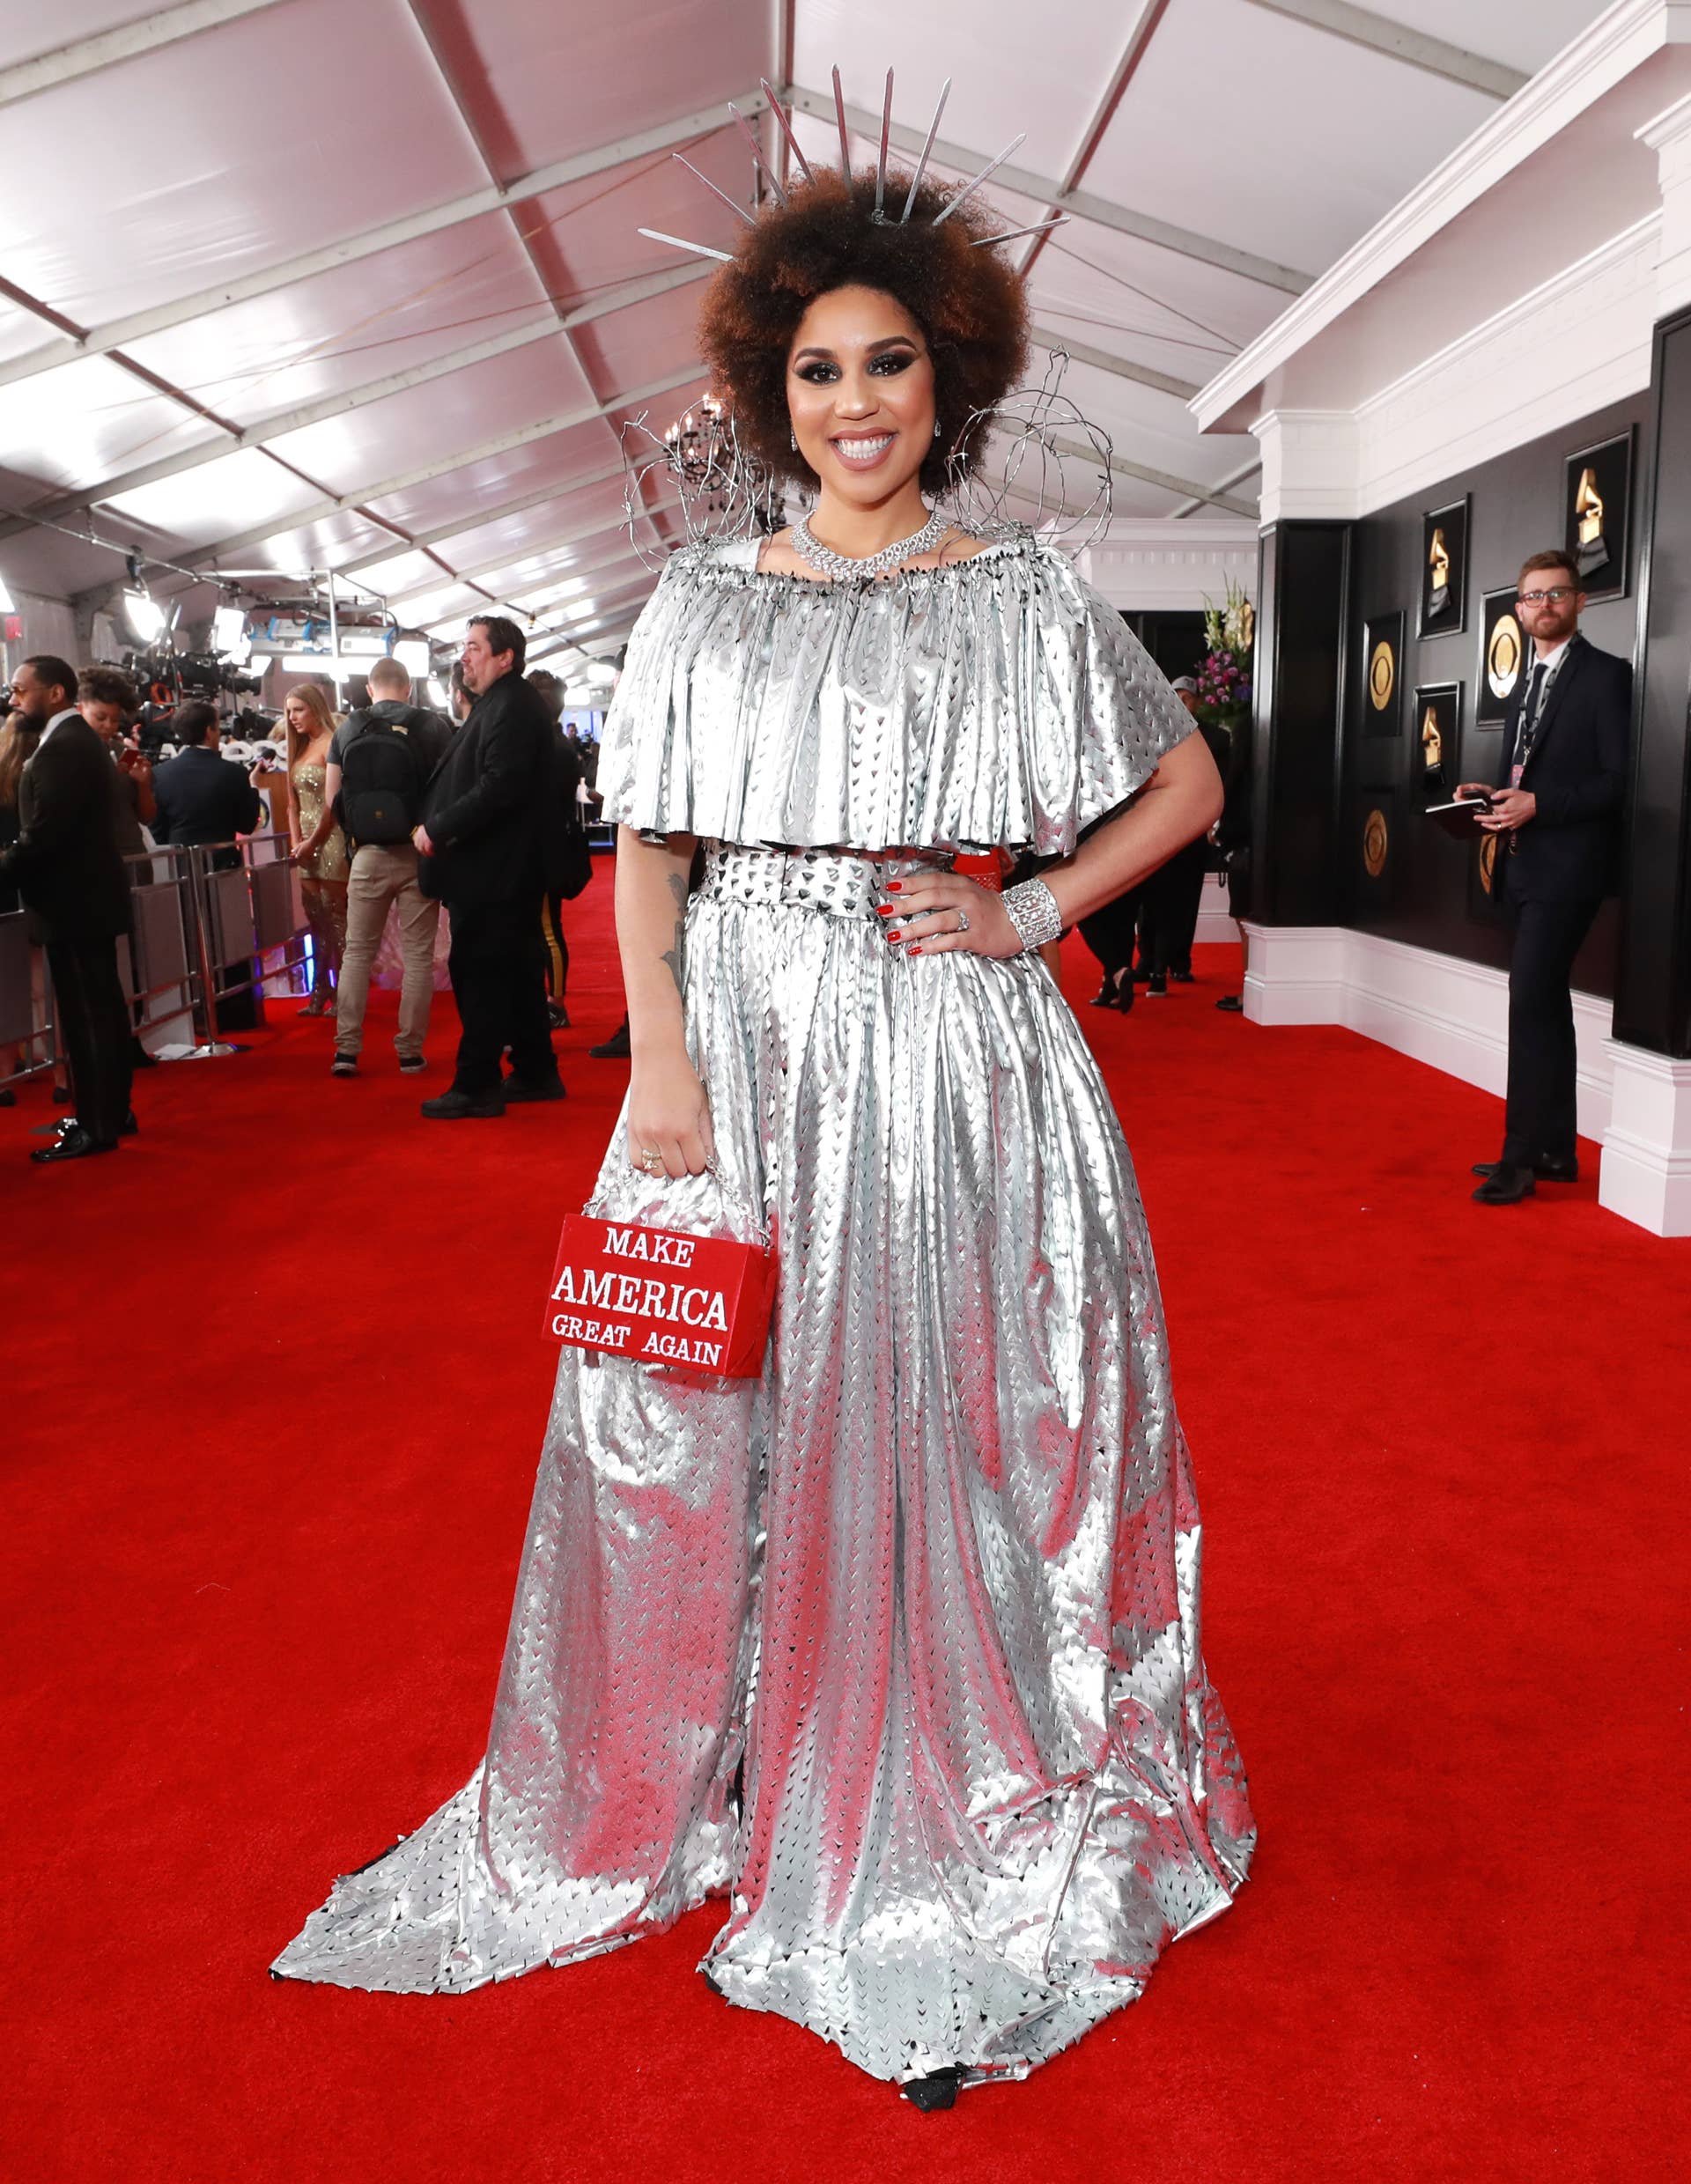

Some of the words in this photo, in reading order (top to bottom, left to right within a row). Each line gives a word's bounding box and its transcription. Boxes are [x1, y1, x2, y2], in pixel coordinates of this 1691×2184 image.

[602, 1227, 695, 1268] MAKE
[550, 1265, 728, 1332] AMERICA
[551, 1315, 631, 1348] GREAT
[641, 1332, 723, 1367] AGAIN
